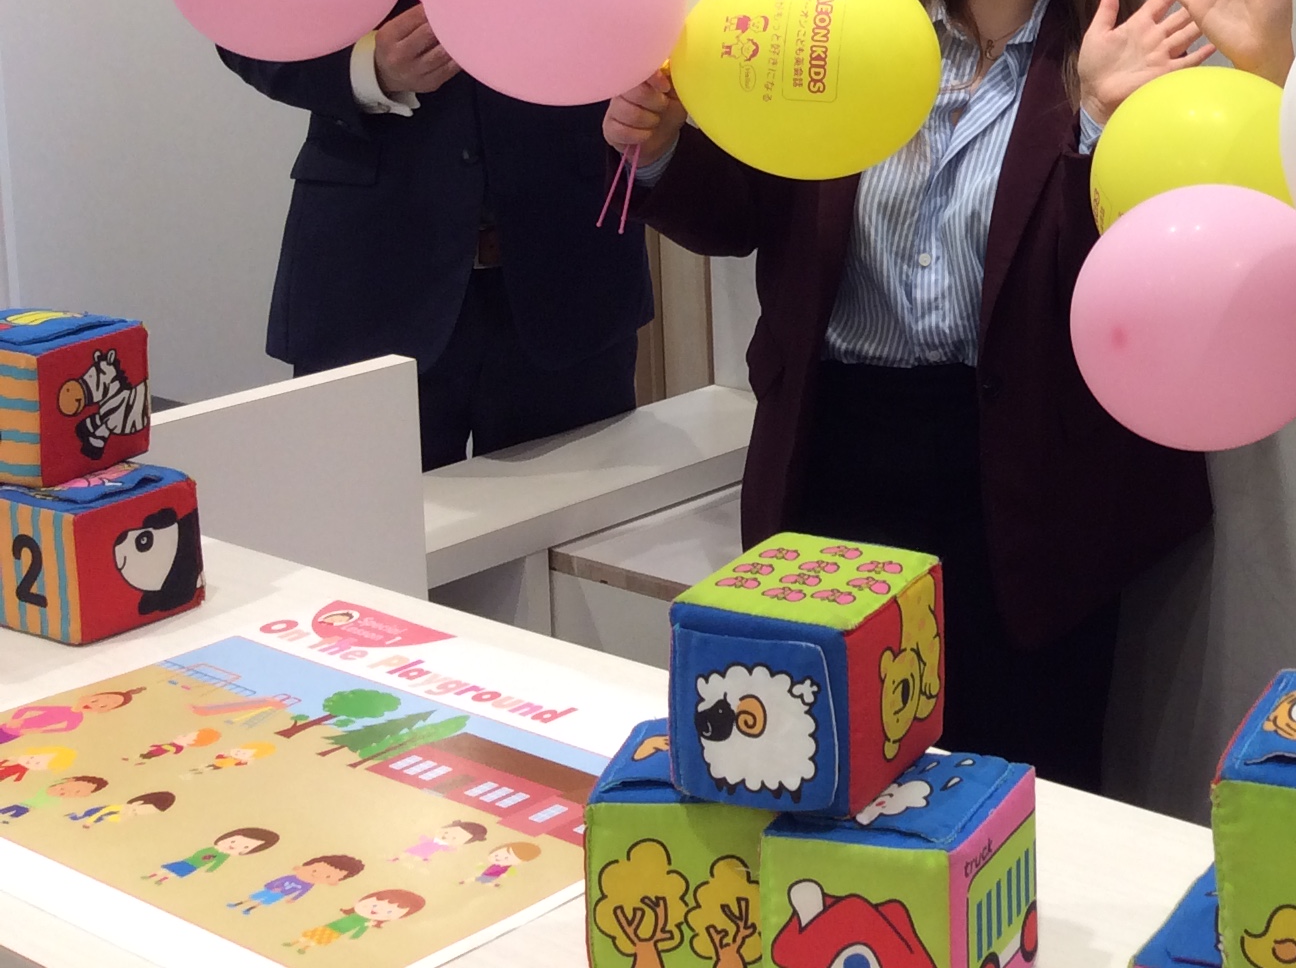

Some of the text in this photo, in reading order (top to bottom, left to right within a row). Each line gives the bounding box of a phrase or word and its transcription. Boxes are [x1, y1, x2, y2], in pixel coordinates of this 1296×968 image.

[808, 44, 829, 94] KIDS
[12, 534, 48, 608] 2
[259, 619, 311, 642] On
[366, 659, 579, 725] Playground
[963, 838, 993, 879] truck
